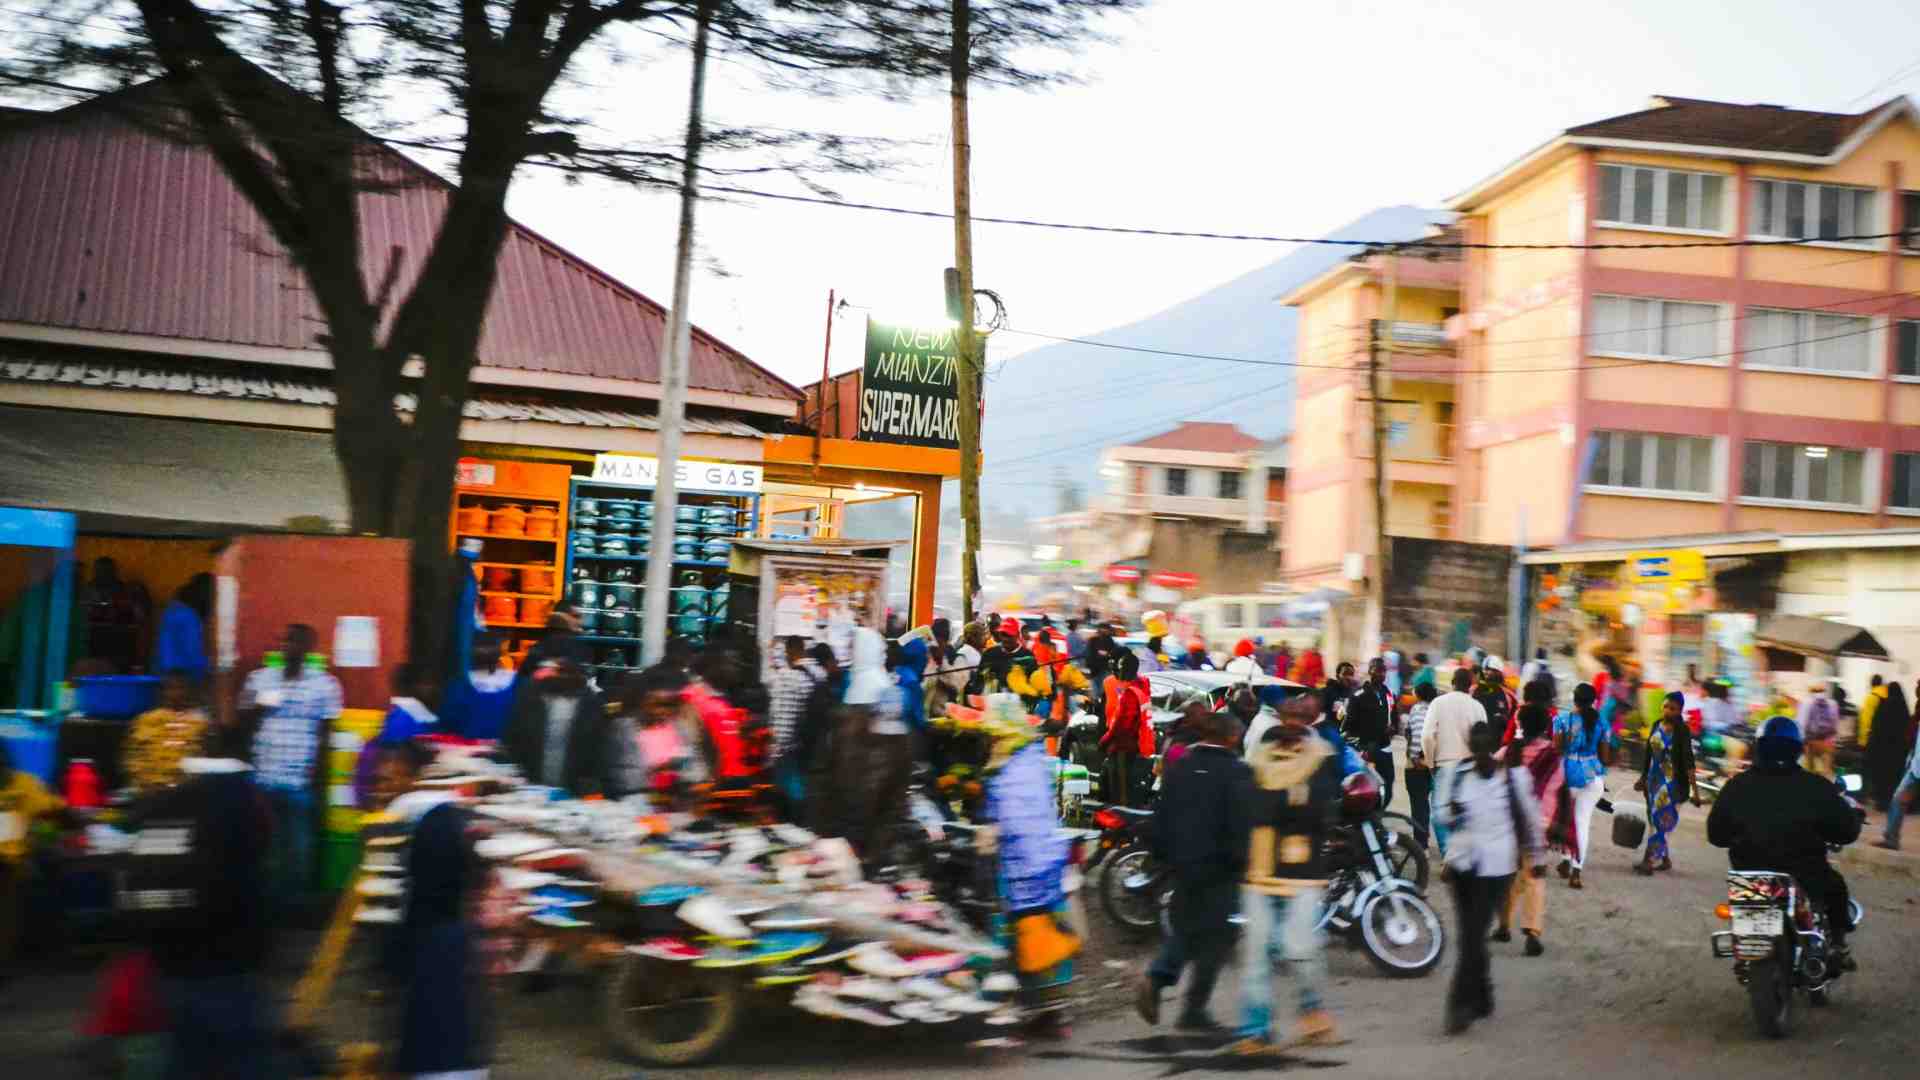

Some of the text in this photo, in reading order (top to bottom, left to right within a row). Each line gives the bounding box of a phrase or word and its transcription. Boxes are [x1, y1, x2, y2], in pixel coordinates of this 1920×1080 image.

[892, 326, 953, 351] NEW
[873, 351, 960, 386] MIANZIN
[861, 388, 961, 440] SUPERMARK
[600, 461, 754, 486] MANS GAS
